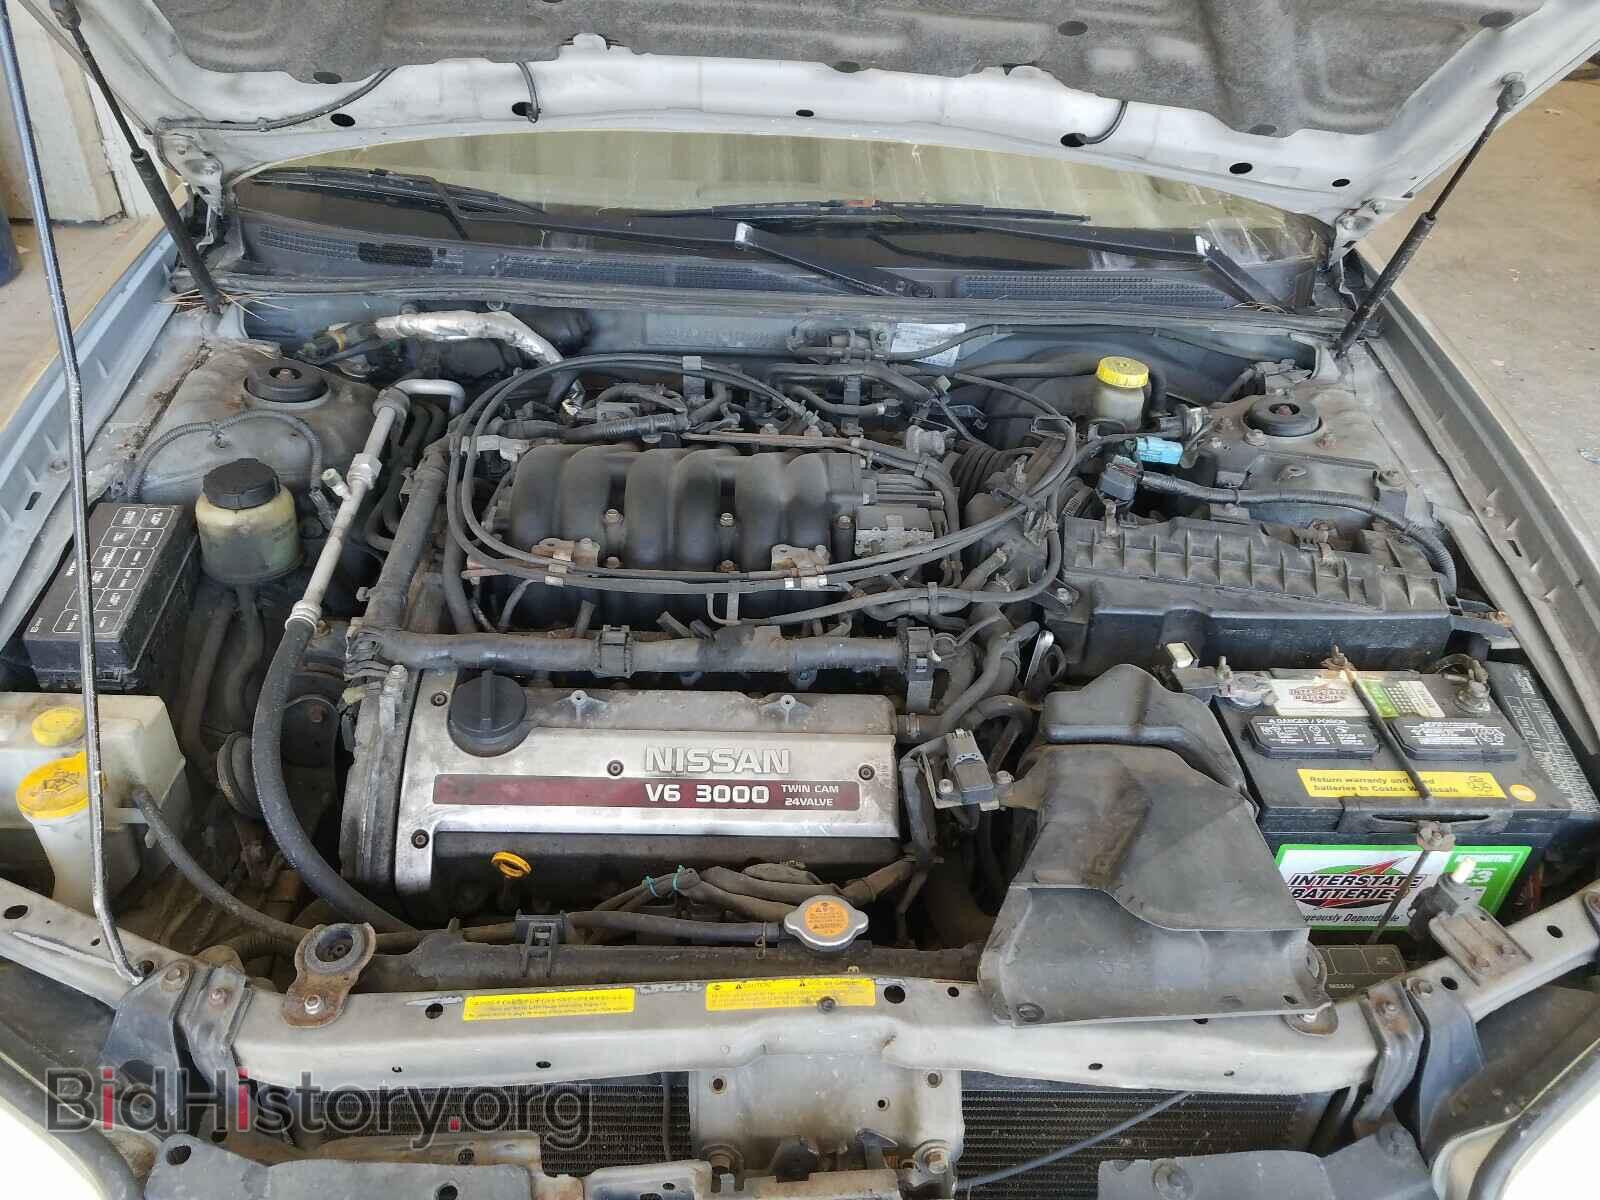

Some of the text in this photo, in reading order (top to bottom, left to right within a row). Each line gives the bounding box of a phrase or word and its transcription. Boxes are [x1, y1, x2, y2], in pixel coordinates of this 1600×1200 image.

[645, 747, 791, 774] NISSAN
[645, 783, 839, 804] V6 3000 TWIN CAM
[784, 797, 833, 807] 24VALVE
[1289, 874, 1422, 888] INTERSTATE
[1291, 887, 1402, 899] BATTERIES
[1344, 913, 1400, 922] Dependle
